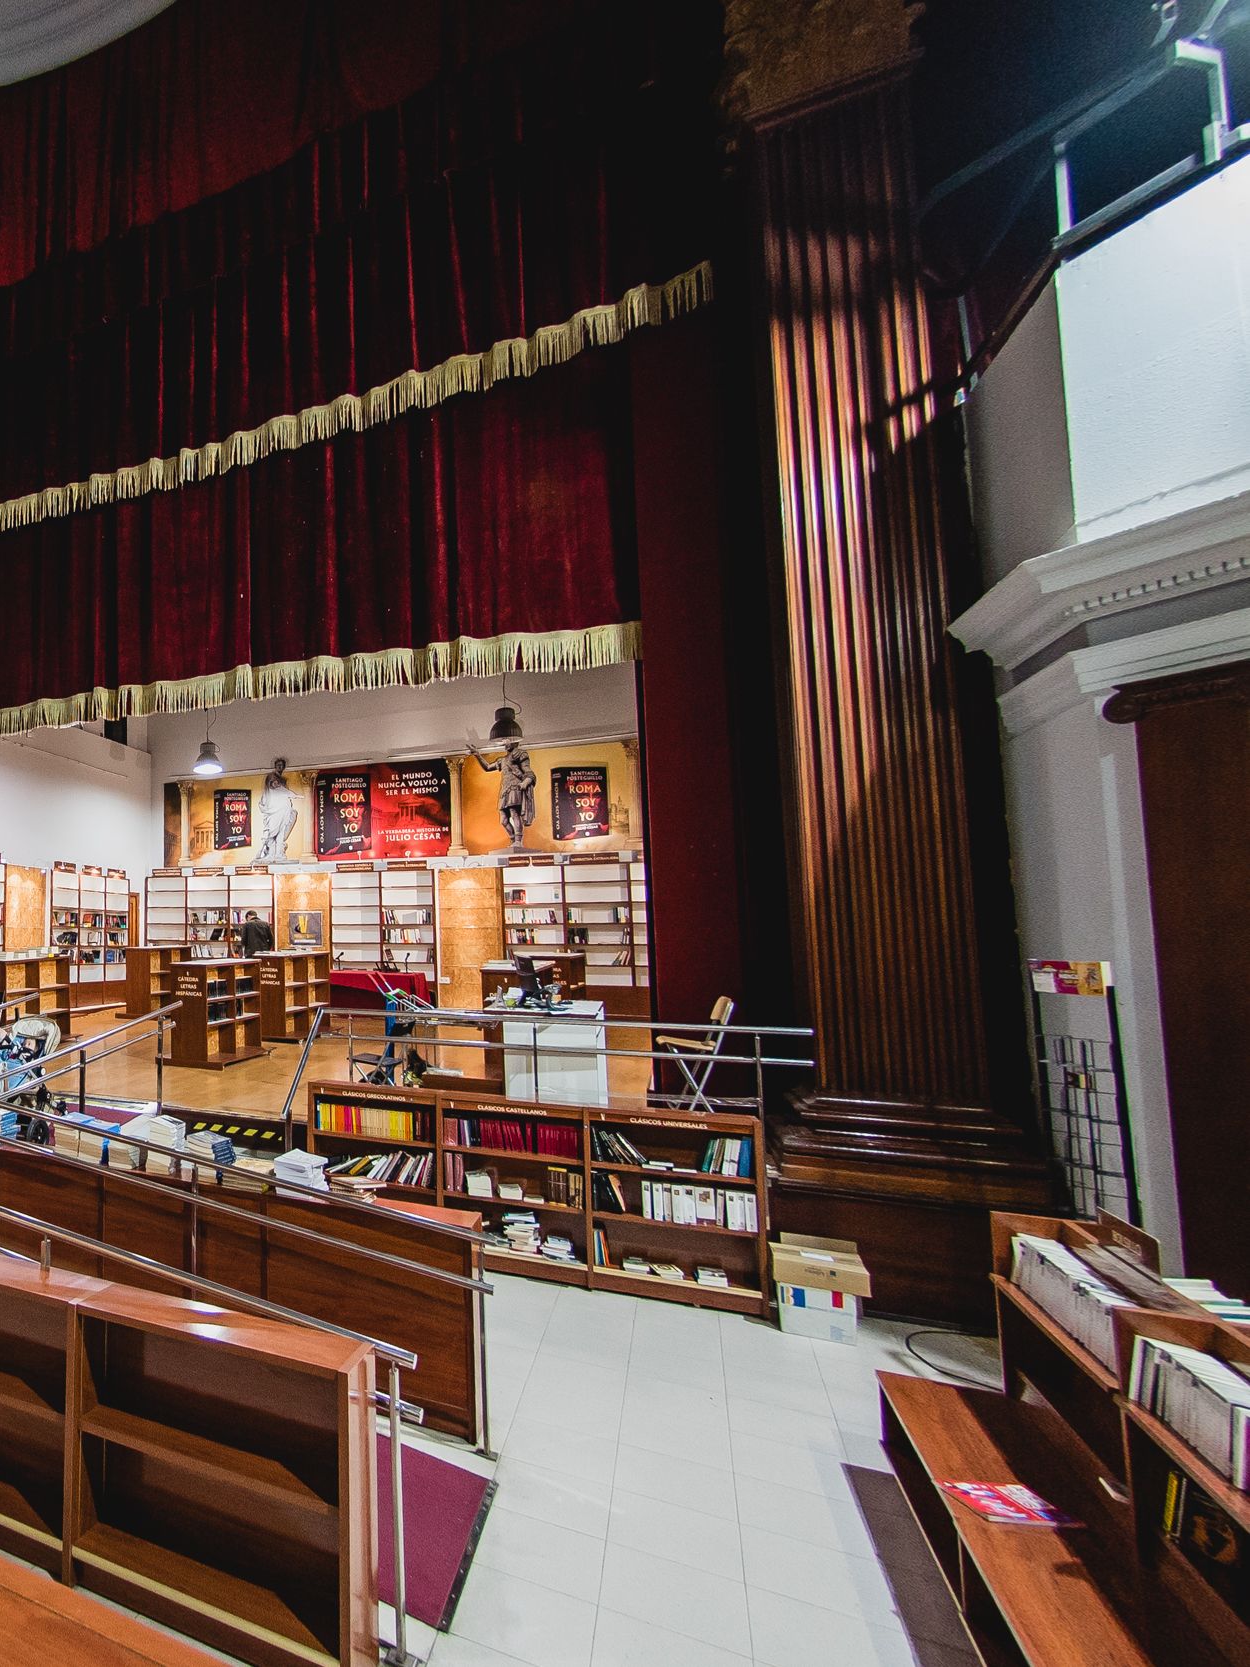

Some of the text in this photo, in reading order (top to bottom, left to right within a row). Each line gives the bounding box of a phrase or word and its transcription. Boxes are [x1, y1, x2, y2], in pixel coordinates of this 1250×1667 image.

[402, 771, 432, 779] MUNDO
[378, 780, 406, 789] NUNCA
[407, 778, 438, 787] VOLVIÓ
[569, 784, 601, 794] ROMA
[412, 786, 439, 794] MISMO
[334, 792, 365, 803] ROMA
[575, 798, 596, 808] SOY
[225, 803, 247, 812] ROMA
[339, 807, 360, 819] SOY
[229, 814, 244, 823] SOY
[579, 811, 595, 822] YO
[231, 826, 242, 835] YO
[343, 822, 358, 834] YO
[385, 831, 441, 842] JULIO CÉSAR
[175, 989, 203, 997] HISPÁNICAS
[342, 1089, 366, 1099] CLÁSICOS
[366, 1092, 406, 1102] GRECOLATINOS
[477, 1104, 506, 1113] CLÁSICOS
[506, 1106, 548, 1116] CASTELLANOS
[629, 1117, 662, 1126] CLÁSICOS
[662, 1120, 708, 1130] UNIVERSALES
